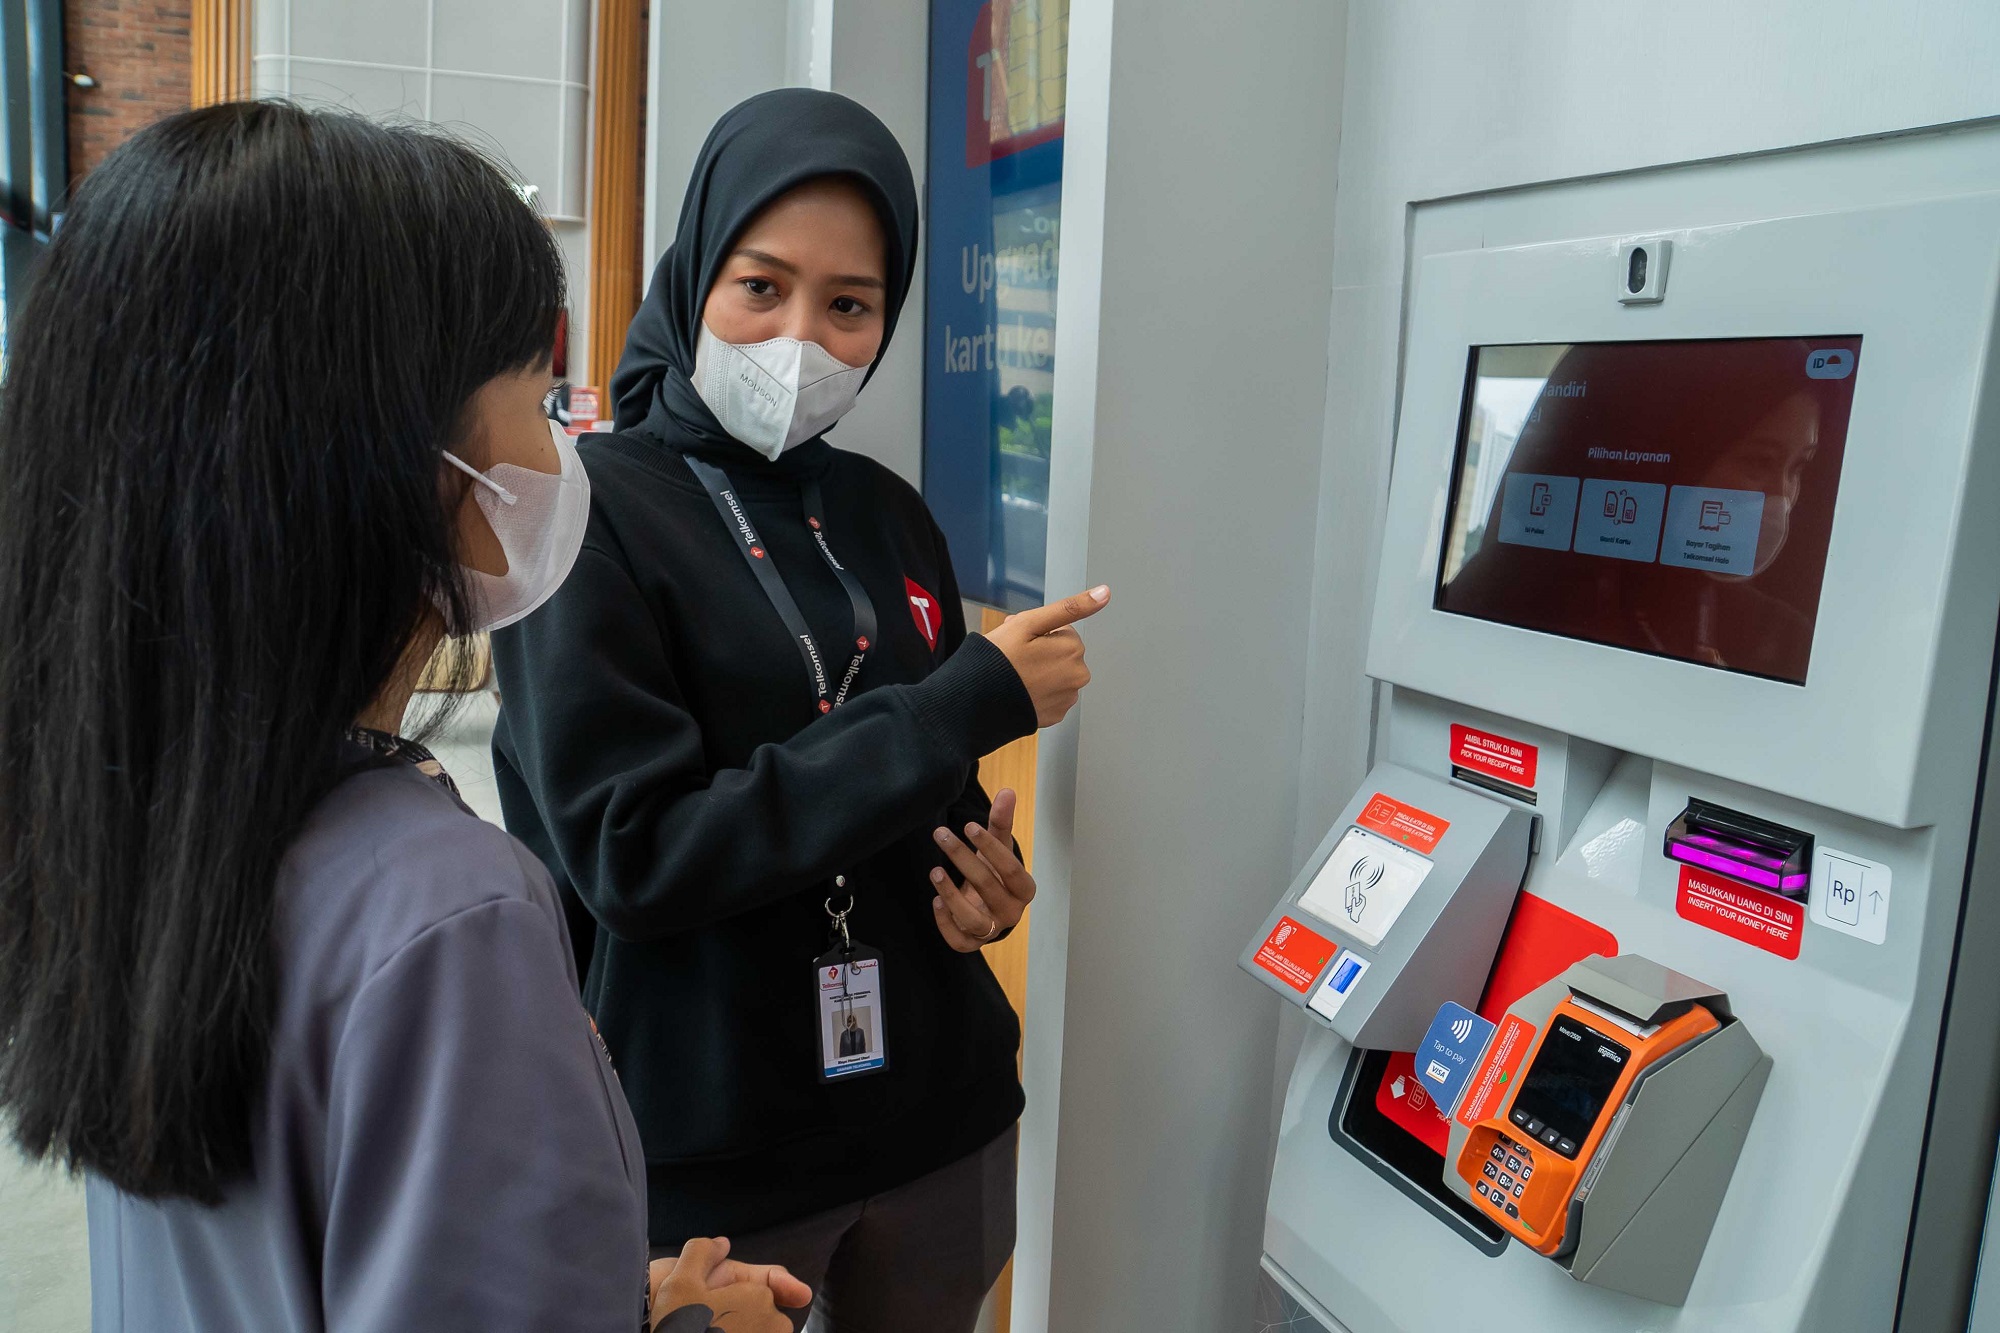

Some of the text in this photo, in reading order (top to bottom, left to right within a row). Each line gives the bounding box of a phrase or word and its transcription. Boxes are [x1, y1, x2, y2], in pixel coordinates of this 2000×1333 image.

[1813, 357, 1825, 369] ID
[740, 373, 777, 407] MOUSON
[1588, 447, 1671, 465] Pilihan Layanan
[720, 490, 756, 545] Telkomsel
[1686, 540, 1731, 551] Bayar Tagihan
[800, 634, 826, 697] Telkomsel
[1465, 734, 1522, 758] AMBIL STRUK DI SINI
[1461, 749, 1524, 775] PICK YOUR RECEIPT HERE
[1688, 879, 1793, 924] MASUKKAN UANG DI SINI
[1833, 880, 1855, 905] Rp
[1688, 896, 1789, 940] INSERT YOUR MONEY HERE
[1559, 1026, 1582, 1041] Move/2500
[1433, 1040, 1466, 1064] Tap to pay
[1598, 1045, 1621, 1063] ingenico
[1432, 1066, 1446, 1078] VISA
[1464, 1021, 1516, 1119] TRANSAKSI KARTU DEBIT/KREDIT
[1474, 1029, 1520, 1120] DEBIT/CREDIT CARD TRANSACTION
[1492, 1148, 1499, 1156] 4
[1485, 1164, 1492, 1173] 7
[1508, 1158, 1516, 1168] 5
[1500, 1175, 1507, 1184] 8
[1523, 1169, 1530, 1178] 6
[1492, 1192, 1498, 1202] 0
[1515, 1187, 1522, 1196] 9
